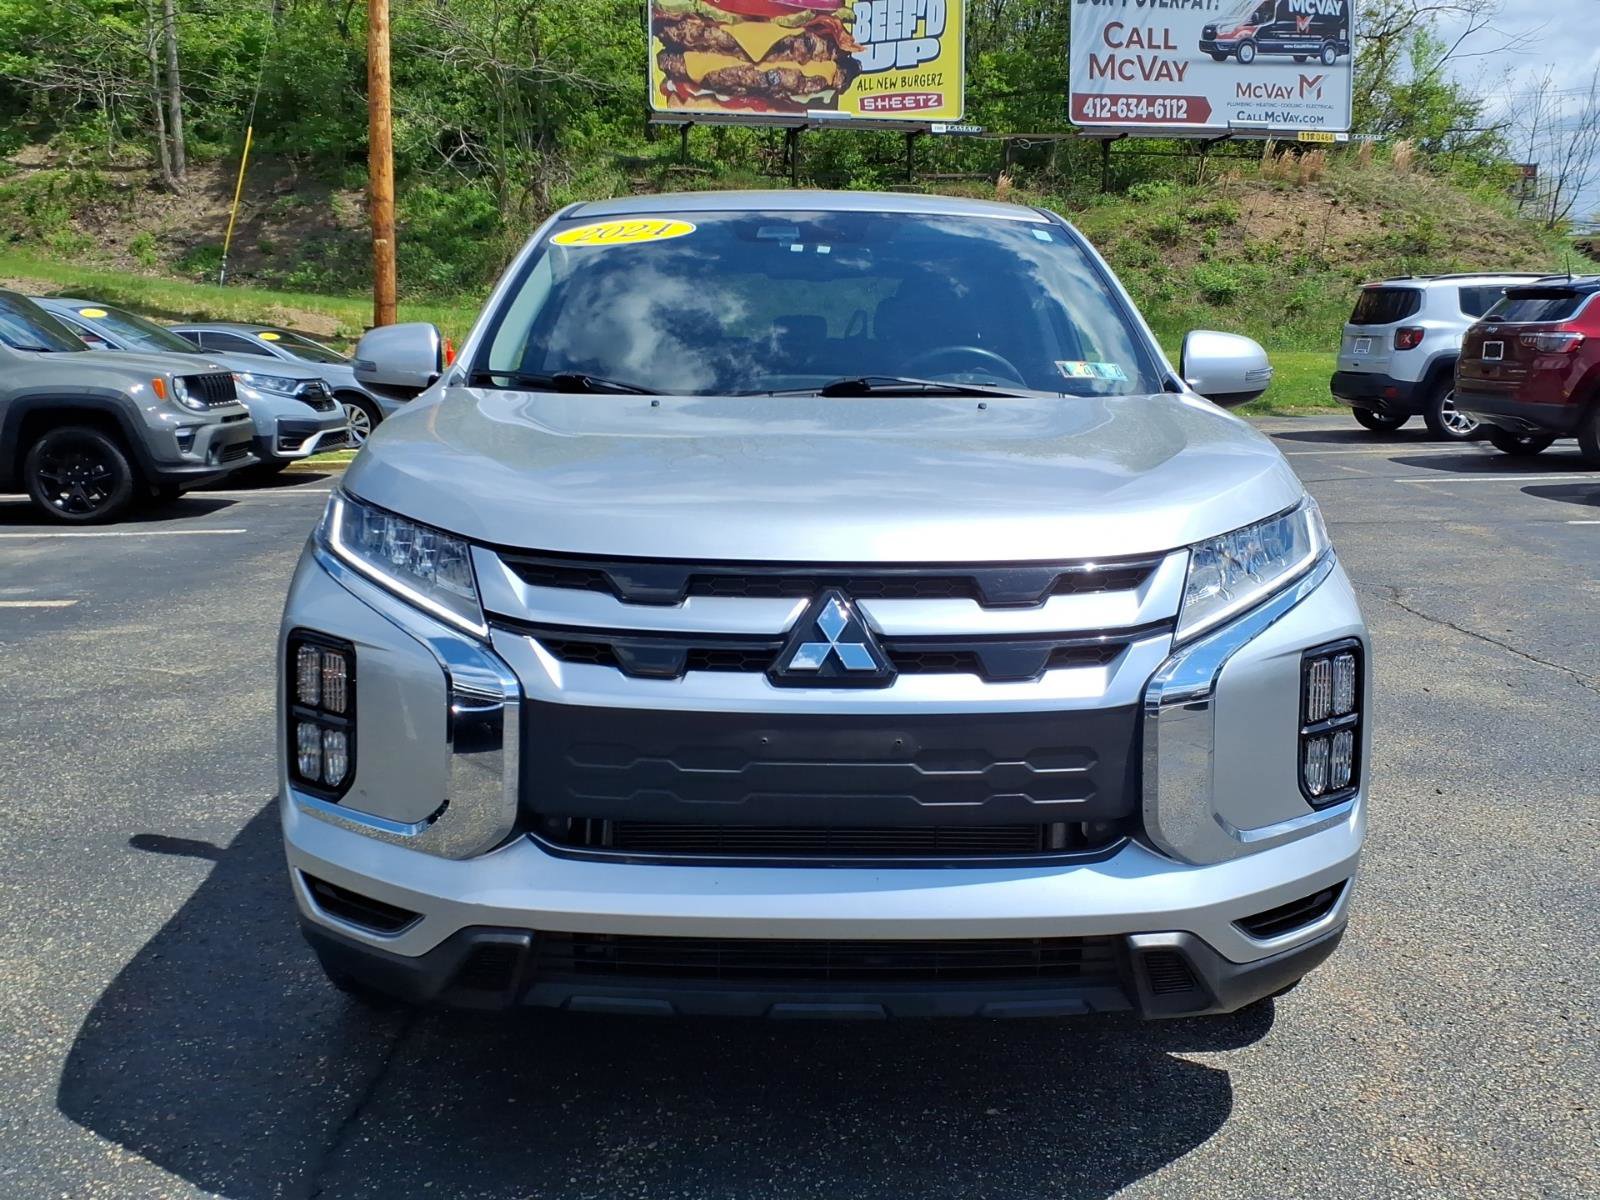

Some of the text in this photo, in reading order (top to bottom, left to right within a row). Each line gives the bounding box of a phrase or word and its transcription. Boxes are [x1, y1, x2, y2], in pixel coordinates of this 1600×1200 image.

[851, 38, 940, 71] UP
[857, 73, 944, 91] ALL NEW BURGERZ
[864, 94, 939, 110] SHEETZ
[1082, 97, 1188, 119] 412-634-6112
